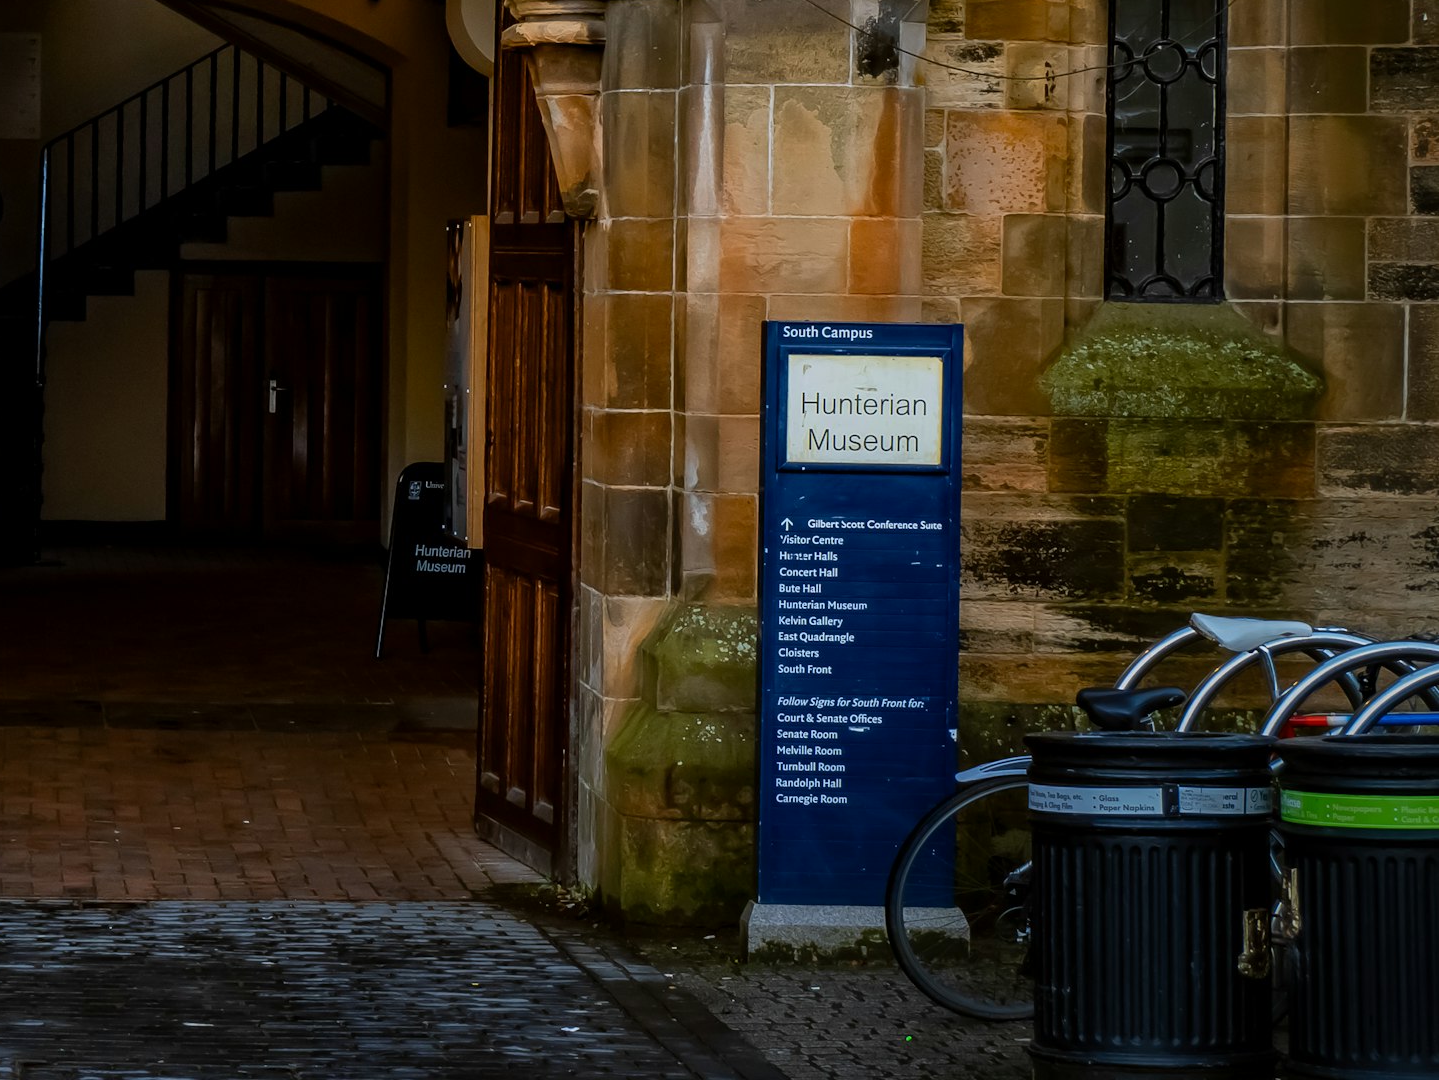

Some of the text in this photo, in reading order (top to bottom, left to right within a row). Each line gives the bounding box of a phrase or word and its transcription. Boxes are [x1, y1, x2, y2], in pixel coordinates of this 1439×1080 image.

[783, 326, 872, 341] South Campus
[801, 392, 927, 416] Hunterian
[808, 428, 919, 452] Museum
[808, 519, 839, 528] Gilbert
[867, 520, 918, 529] Conference
[920, 521, 942, 529] Suite
[780, 535, 843, 545] Visitor Centre
[415, 544, 471, 559] Hunterian
[814, 552, 837, 561] Halls
[416, 560, 466, 573] Museum
[780, 568, 837, 577] Concert Hall
[779, 584, 821, 593] Bute Hall
[779, 600, 867, 610] Hunterian Museum
[779, 616, 843, 628] Kelvin Gallery
[779, 632, 854, 644] East Quadrangle
[779, 648, 819, 657] Cloisters
[778, 664, 831, 674] South Front
[778, 697, 924, 708] Follow Signs for South Front for:
[777, 713, 882, 723] Court & Senate Offices
[777, 729, 837, 739] Senate Room
[777, 745, 841, 755] Melville Room
[777, 762, 845, 771] Turnbull Room
[776, 778, 841, 789] Randolph Hall
[776, 794, 847, 805] Carnegie Room
[1049, 802, 1060, 810] Cling
[1099, 804, 1155, 813] Paper Napkins
[1332, 804, 1382, 815] Newspapers
[1401, 806, 1426, 814] Plastic
[1332, 813, 1355, 823] Paper
[1401, 815, 1421, 823] Card
